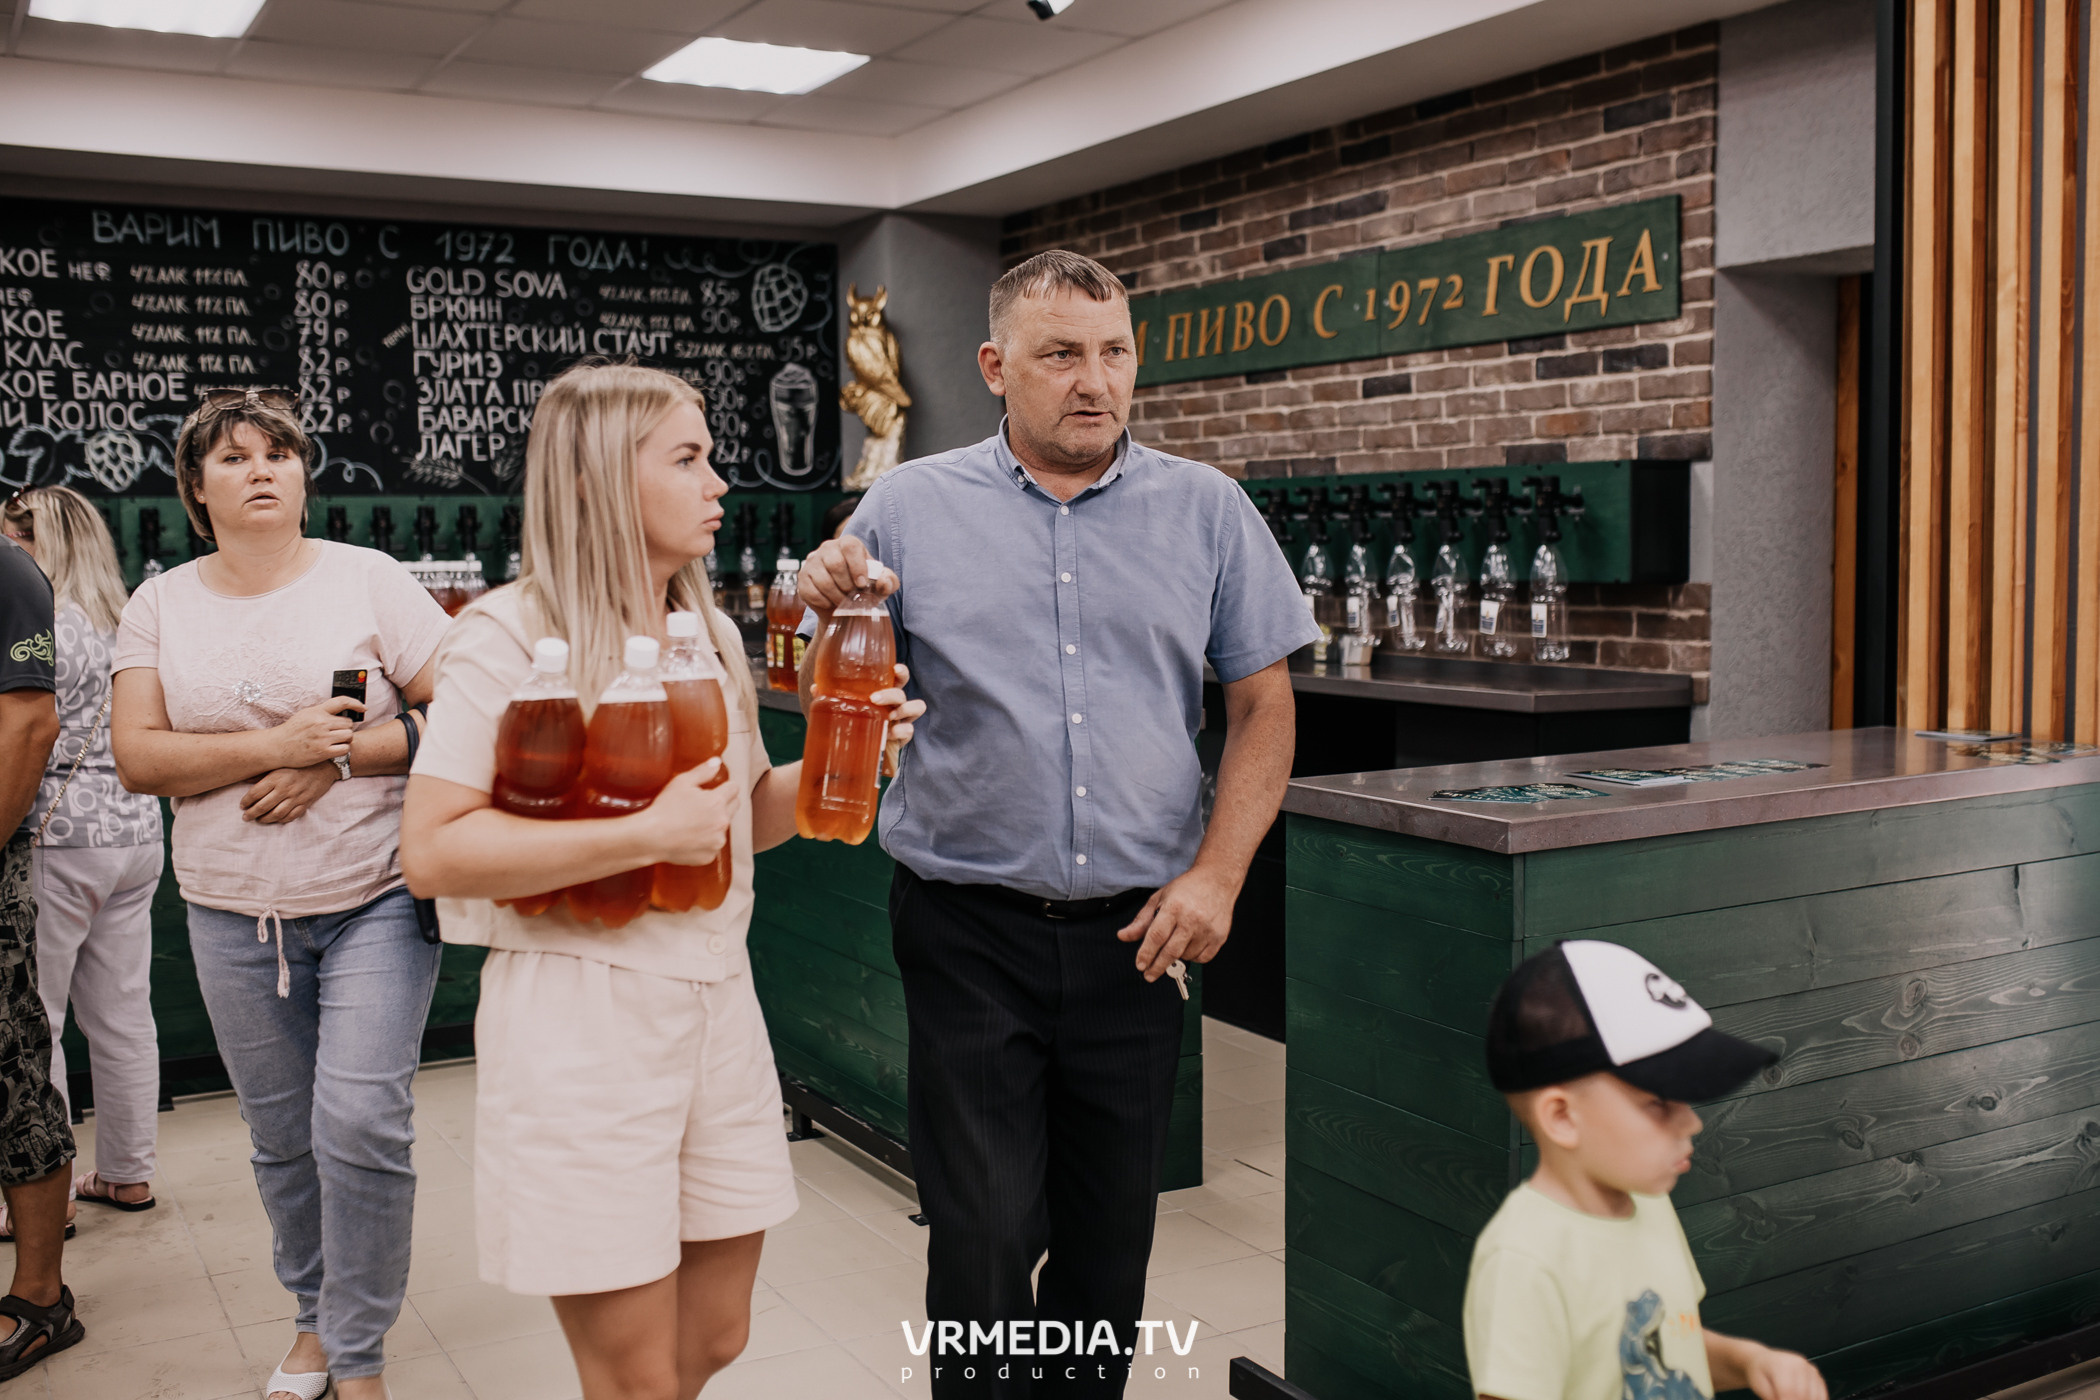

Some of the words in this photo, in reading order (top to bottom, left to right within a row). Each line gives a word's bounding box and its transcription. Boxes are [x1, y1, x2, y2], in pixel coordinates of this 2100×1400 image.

[92, 209, 220, 248] ВАРИМ
[252, 218, 350, 256] ПИВО
[378, 225, 401, 260] С
[435, 231, 517, 264] 1972
[549, 237, 649, 273] ГОДА!
[295, 260, 332, 289] 80
[406, 265, 486, 296] GOLD
[494, 269, 568, 300] SOVA
[293, 289, 332, 317] 80
[411, 294, 503, 321] БРЮНН
[1165, 293, 1291, 362] ПИВО
[1313, 284, 1343, 339] С
[1364, 272, 1465, 330] 1972
[1482, 228, 1663, 324] ГОДА
[296, 318, 330, 346] 79
[411, 320, 586, 354] ШАХТЕРСКИЙ
[592, 328, 673, 356] СТАУТ
[298, 345, 332, 375] 82
[413, 350, 503, 378] ГУРМЭ
[72, 371, 188, 401] БАРНОЕ
[298, 374, 333, 403] 82
[415, 376, 505, 405] ЗЛАТА
[43, 400, 149, 431] КОЛОС
[299, 403, 335, 433] 82
[414, 432, 506, 461] ЛАГЕР
